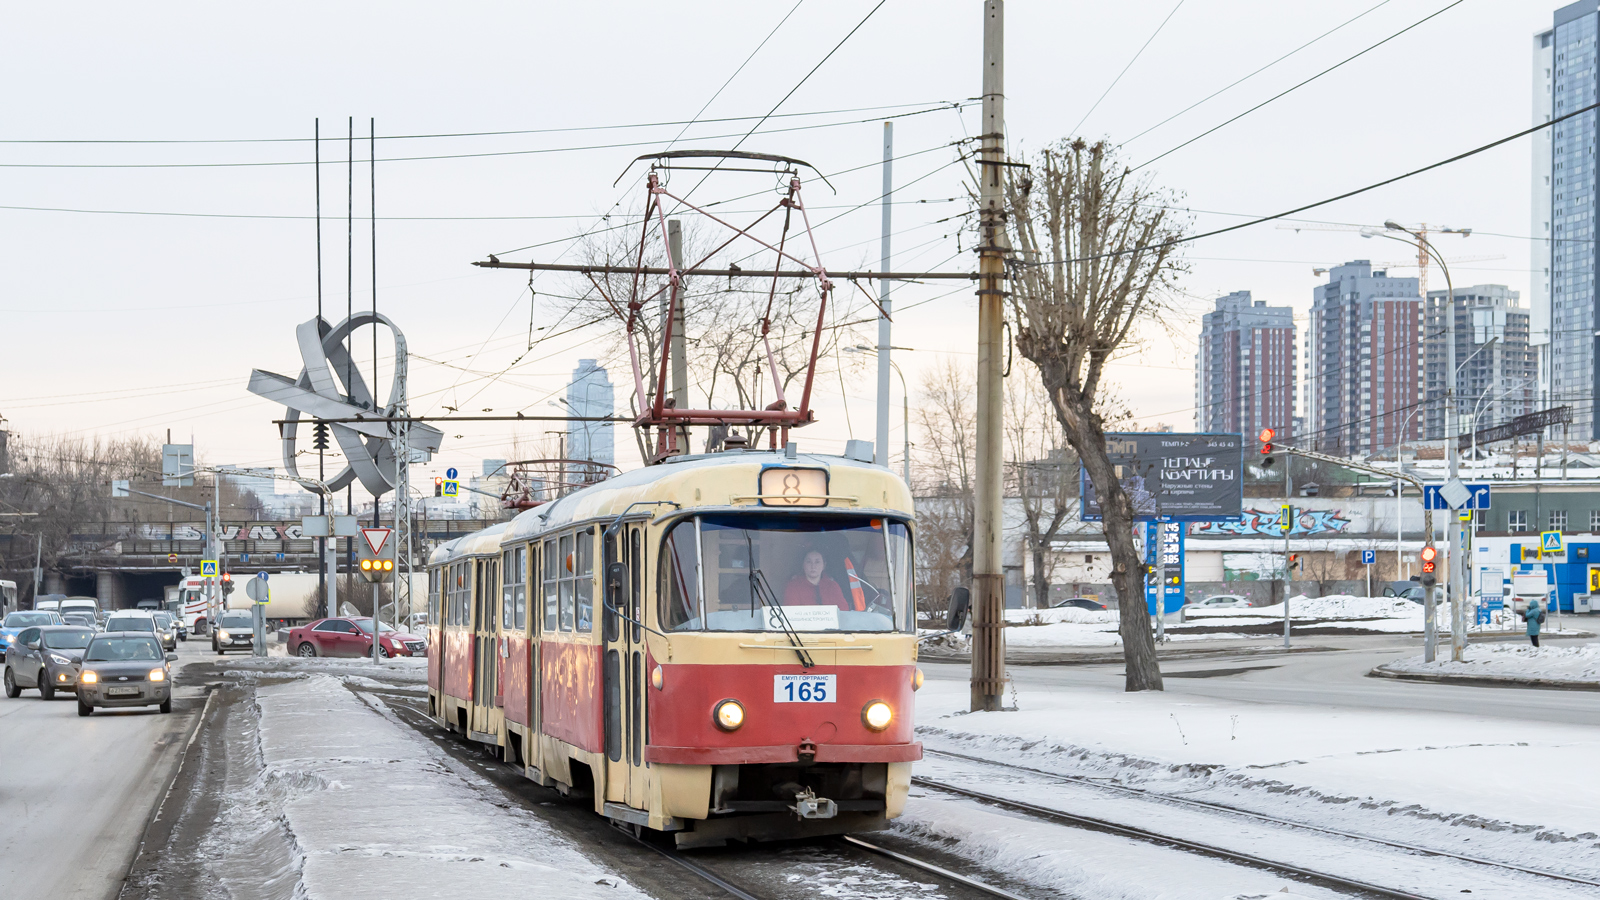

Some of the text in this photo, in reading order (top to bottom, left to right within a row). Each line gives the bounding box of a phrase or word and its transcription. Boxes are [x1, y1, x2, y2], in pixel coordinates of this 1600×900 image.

[1105, 441, 1138, 454] ЕМП
[1160, 469, 1234, 481] КВАРТИРЫ
[782, 473, 801, 504] 8
[1365, 551, 1374, 562] P
[1422, 562, 1434, 573] 22
[769, 607, 784, 629] 8
[784, 681, 827, 702] 165
